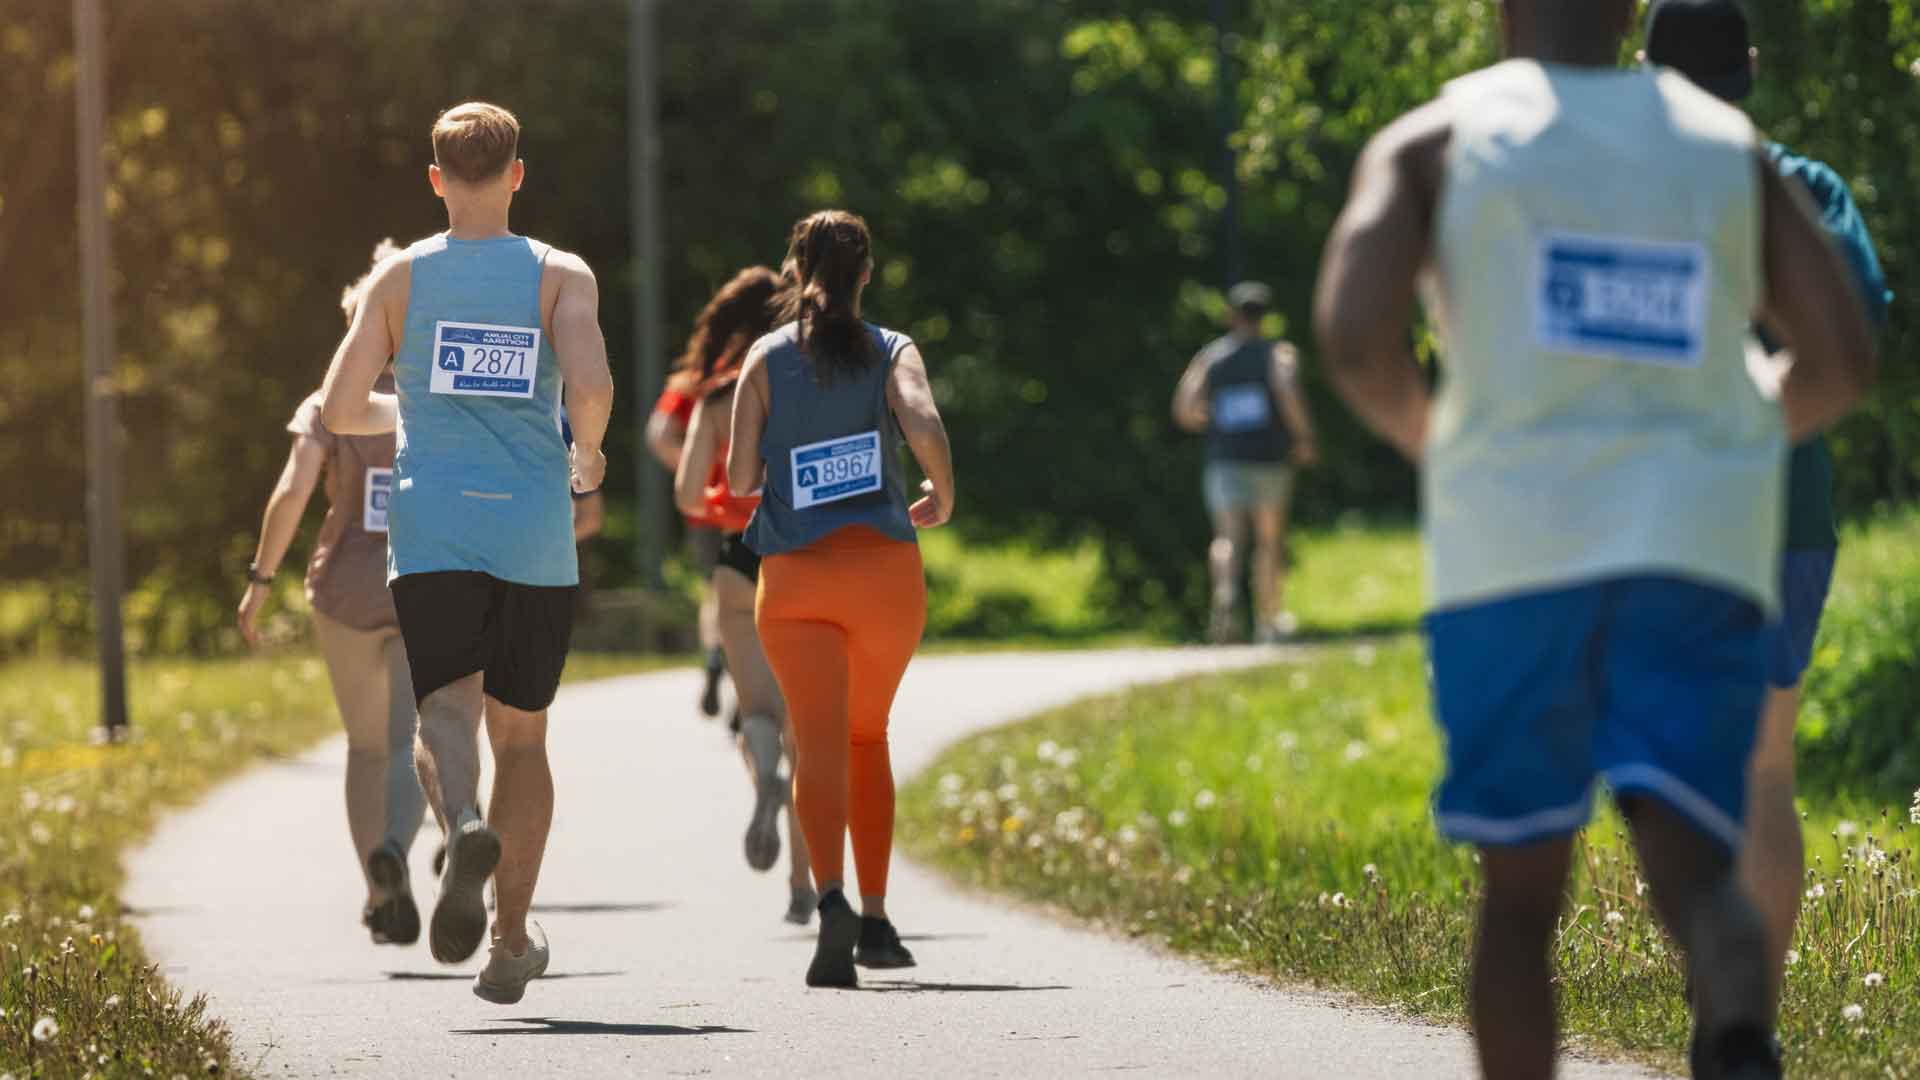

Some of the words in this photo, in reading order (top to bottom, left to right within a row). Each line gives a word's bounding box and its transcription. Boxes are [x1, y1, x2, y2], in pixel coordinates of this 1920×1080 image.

[444, 351, 458, 367] A
[472, 348, 525, 376] 2871
[802, 469, 815, 486] A
[823, 451, 873, 482] 8967
